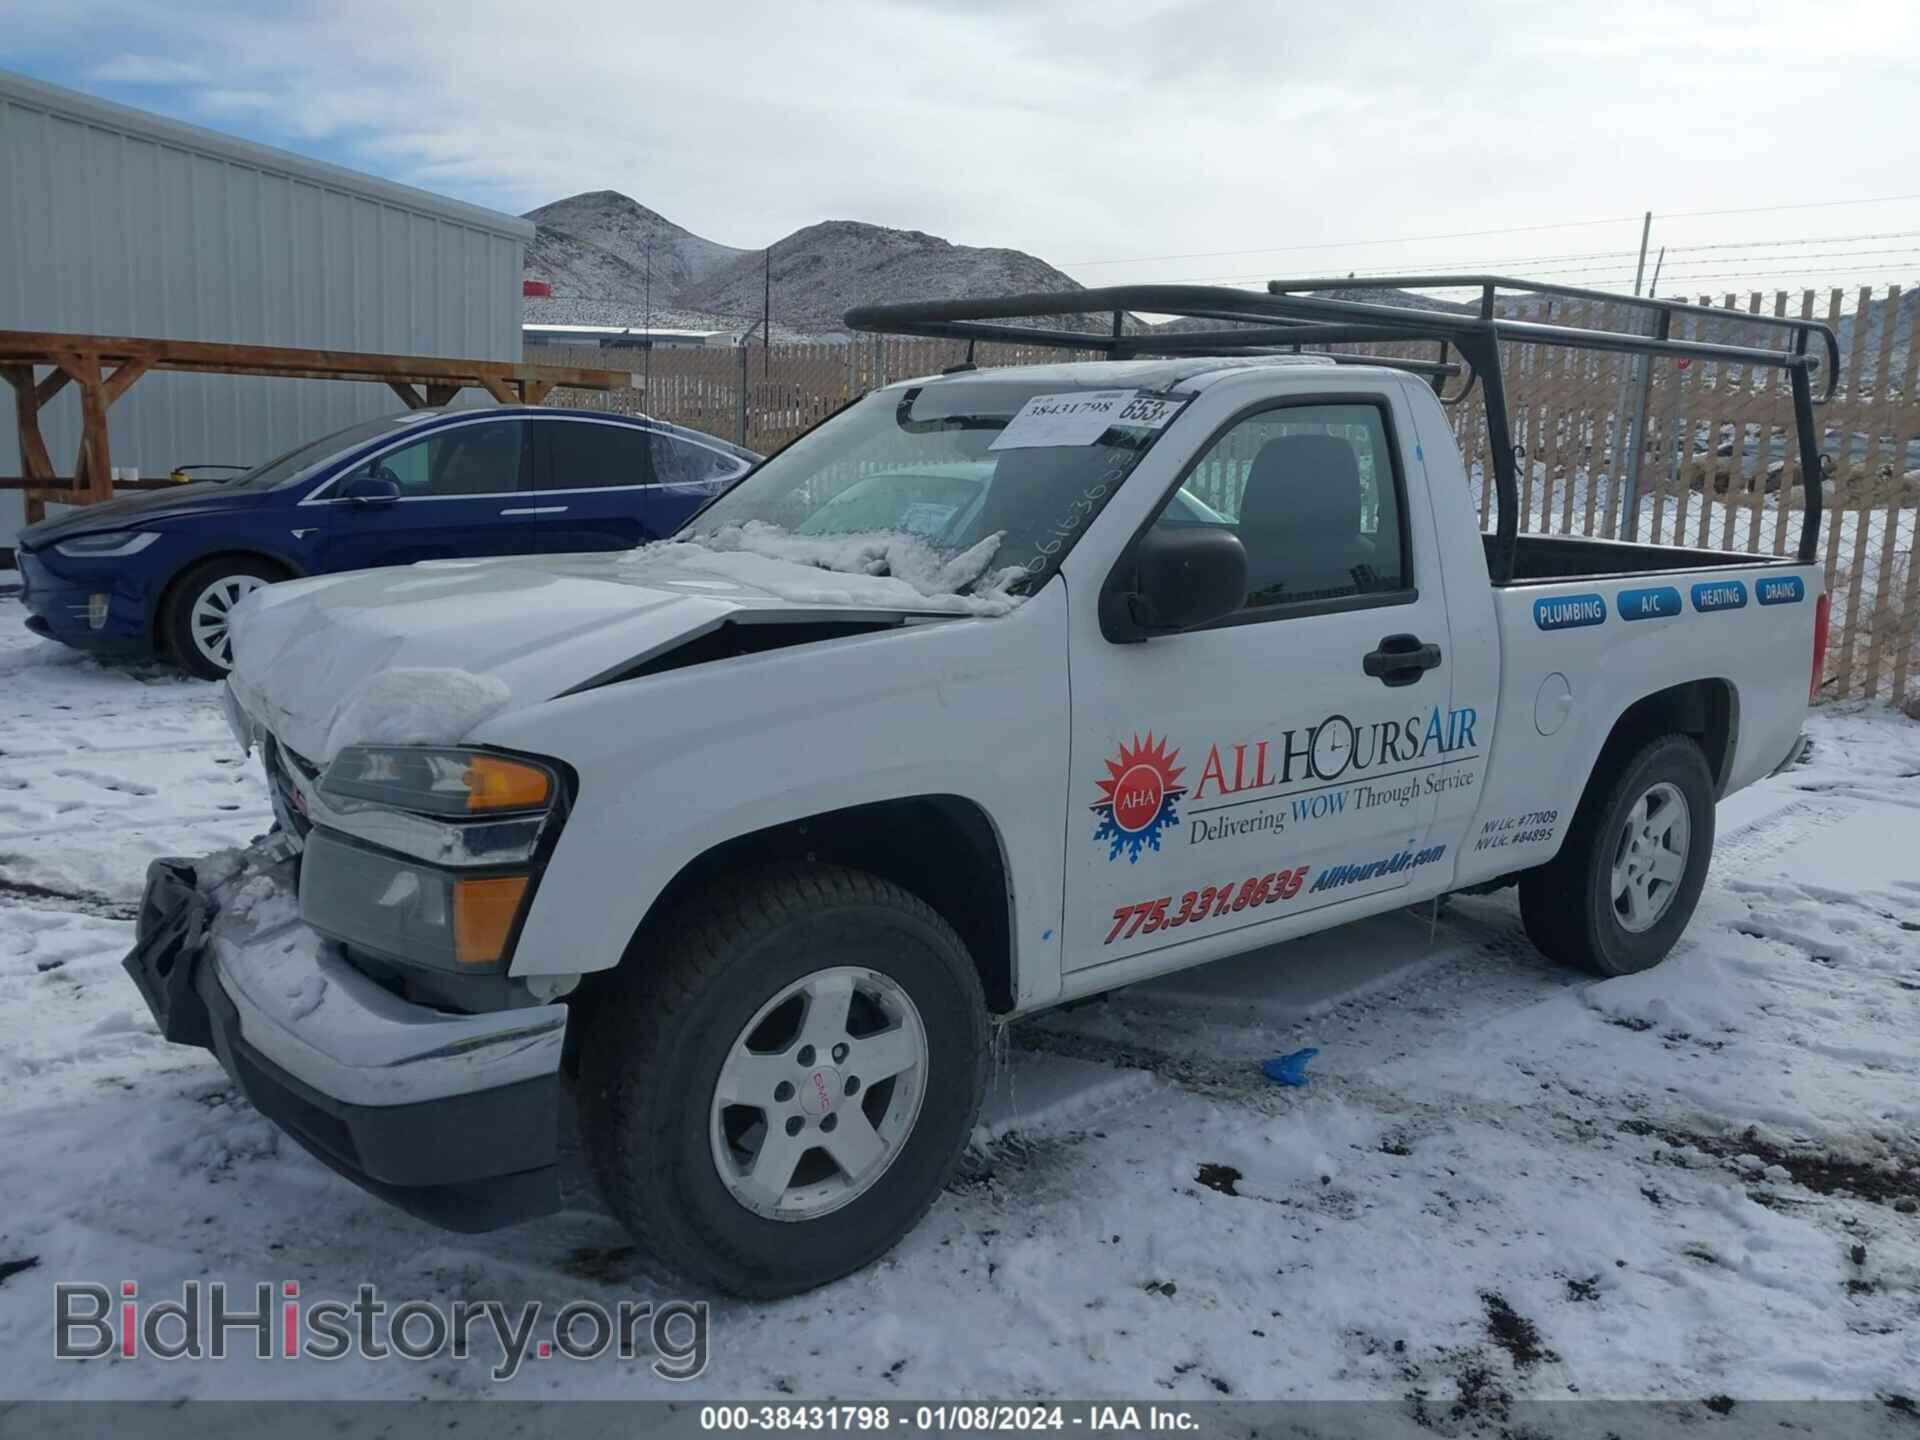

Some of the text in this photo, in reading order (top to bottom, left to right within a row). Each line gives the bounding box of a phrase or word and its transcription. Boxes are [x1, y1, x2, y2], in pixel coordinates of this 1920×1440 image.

[1025, 401, 1114, 417] 38431798
[1700, 587, 1740, 605] HEATING
[1766, 582, 1796, 599] DRAINS
[1539, 600, 1602, 624] PLUMBING
[1641, 595, 1660, 613] A/C
[1121, 789, 1157, 810] AHA
[1189, 769, 1474, 844] Delivering WOW Through Service
[1104, 844, 1447, 945] 775.331.8635 AllHoursAir.com
[813, 1072, 830, 1112] GMC
